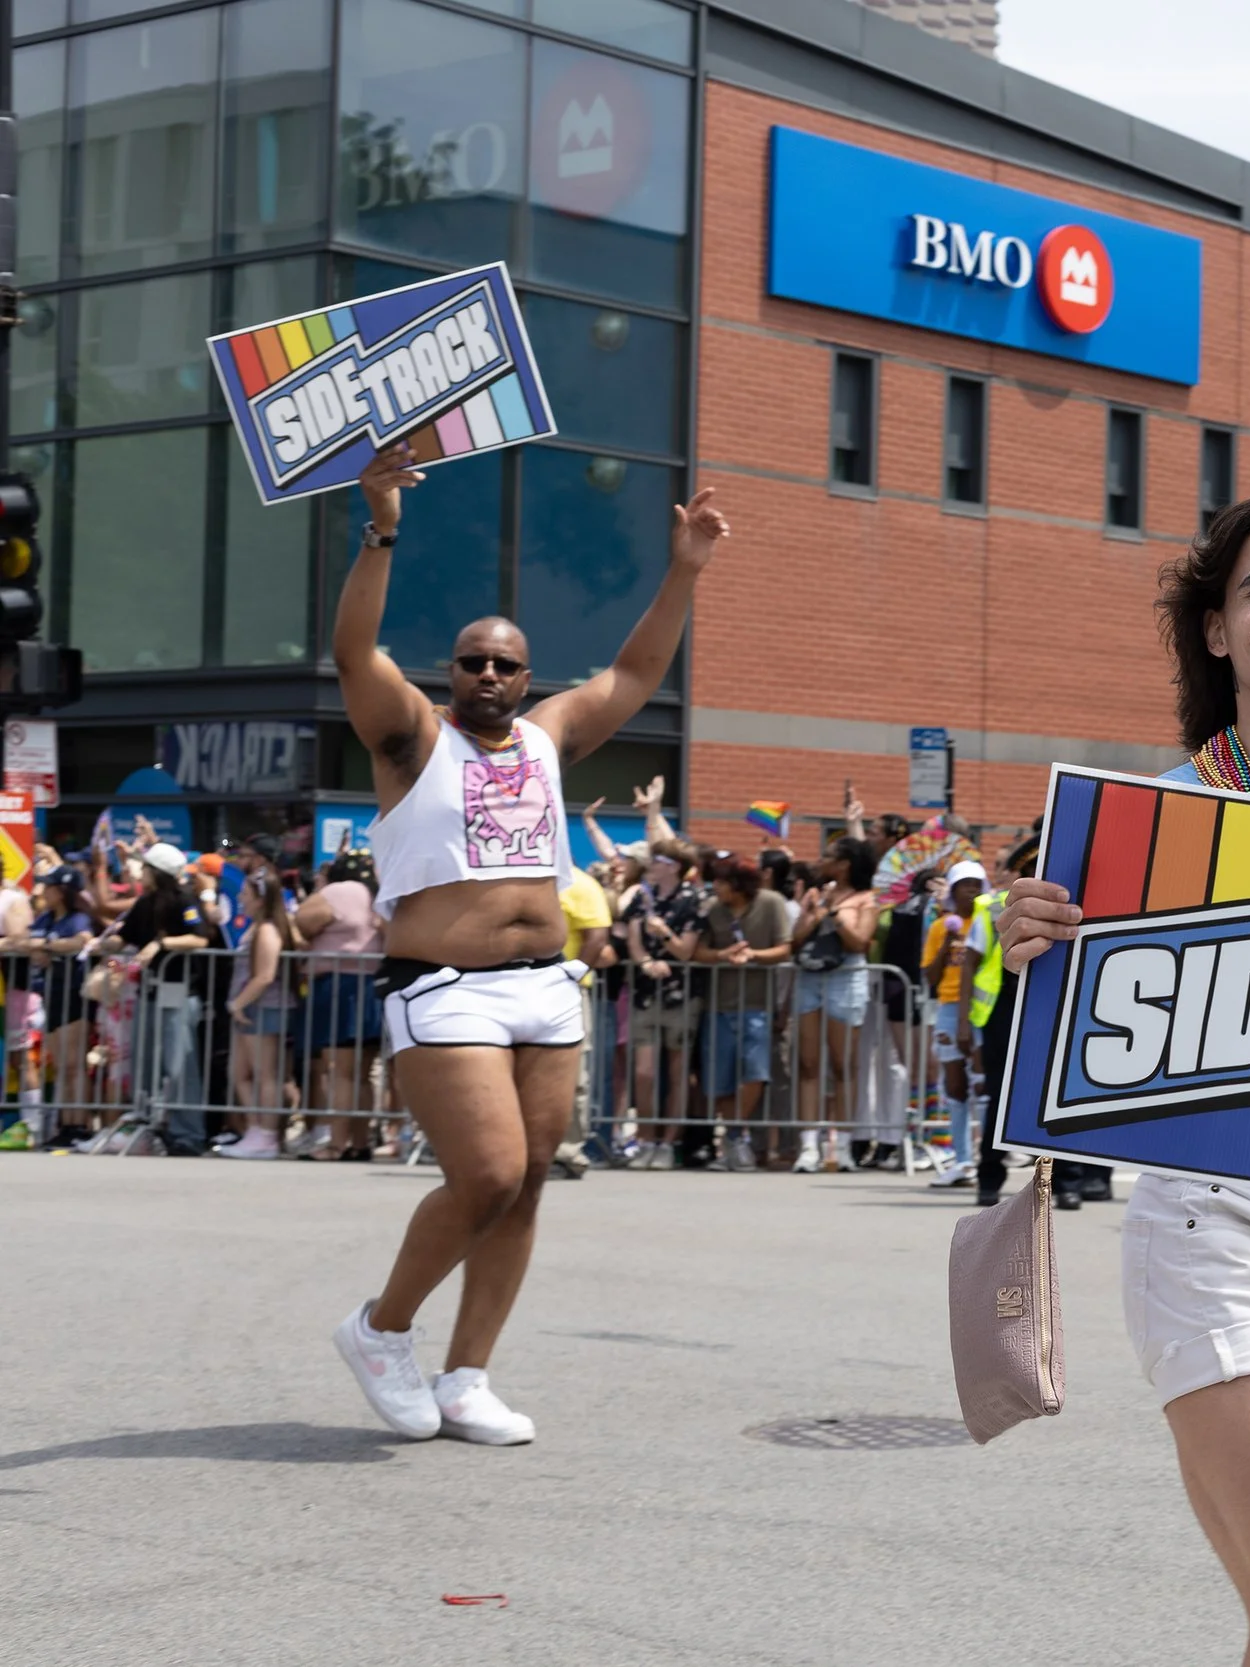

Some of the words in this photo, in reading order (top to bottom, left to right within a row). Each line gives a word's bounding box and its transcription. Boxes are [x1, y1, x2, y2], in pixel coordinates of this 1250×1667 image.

[911, 213, 1033, 289] BMO
[264, 299, 501, 464] SIDETRACK
[997, 1287, 1023, 1318] SM
